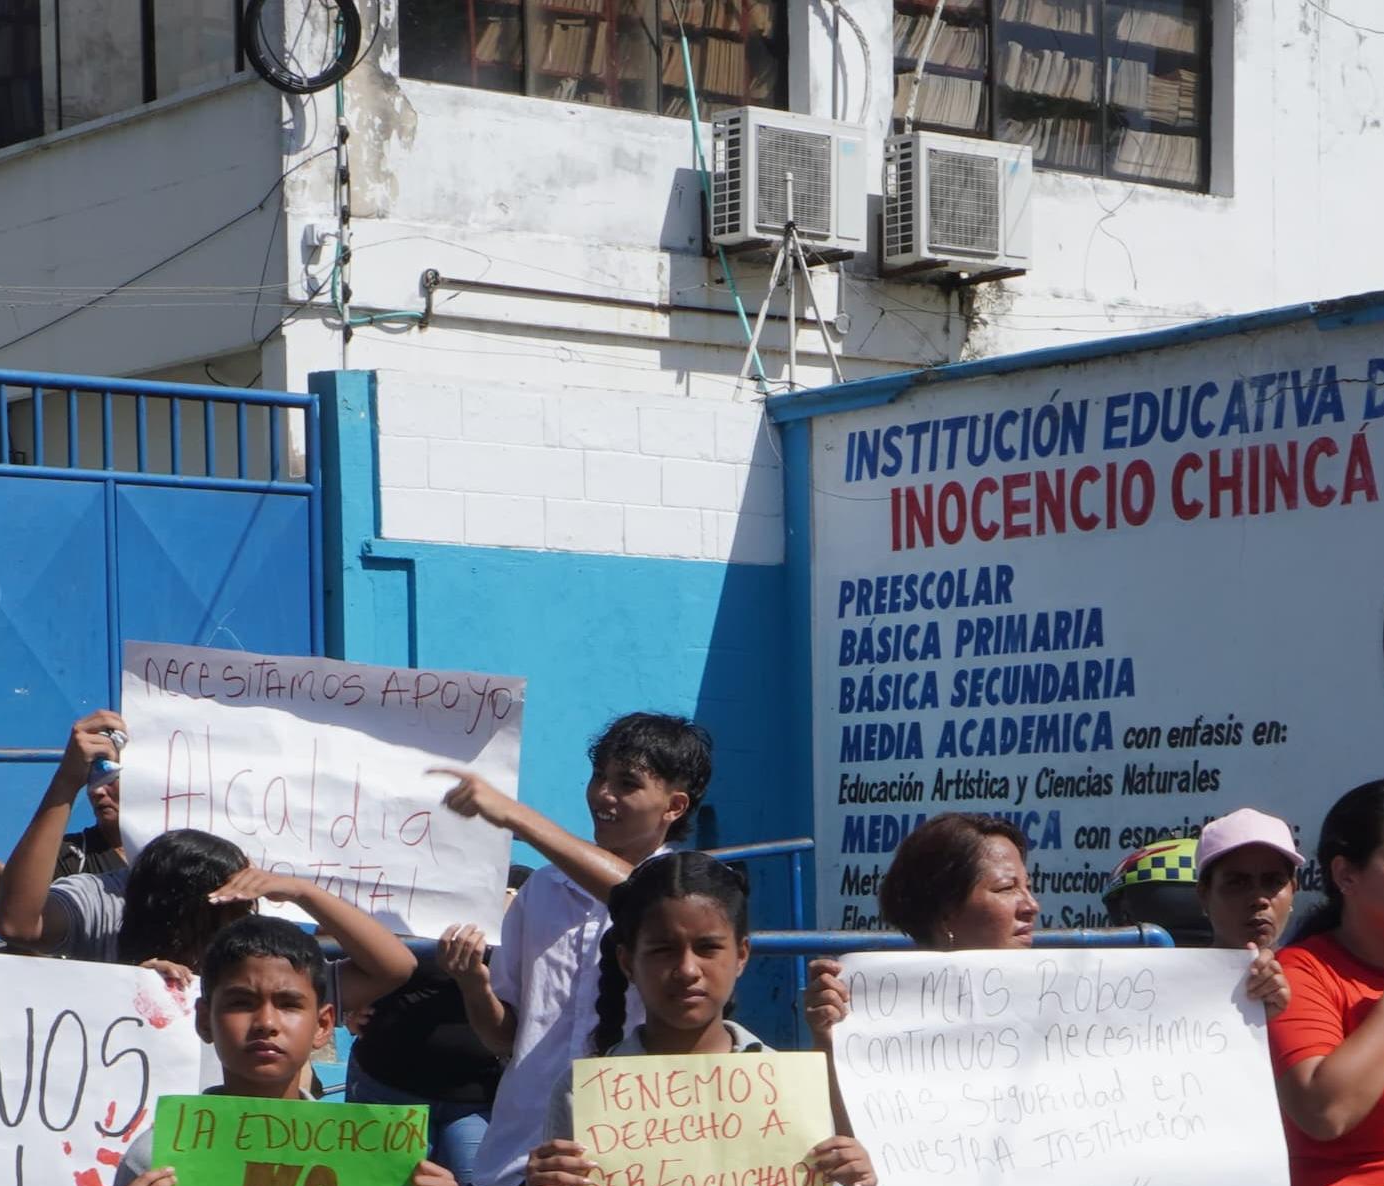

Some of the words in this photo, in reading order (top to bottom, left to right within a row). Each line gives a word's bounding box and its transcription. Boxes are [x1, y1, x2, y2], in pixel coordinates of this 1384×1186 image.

[845, 389, 1088, 483] INSTITUCIÓN
[1103, 365, 1345, 451] EDUCATIVA
[891, 459, 1155, 551] INOCENCIO
[1171, 422, 1378, 521] CHINCÁ
[838, 565, 1014, 618] PREESCOLAR
[839, 618, 941, 667] BÁSICA
[955, 608, 1104, 657] PRIMARIA
[839, 667, 939, 713] BÁSICA
[951, 658, 1135, 708] SECUNDARIA
[840, 721, 924, 763] MEDIA
[936, 711, 1113, 759] ACADEMICA
[1123, 724, 1161, 750] con
[1252, 719, 1288, 746] en:
[838, 772, 924, 805] Educación
[931, 768, 1010, 802] Artística
[1015, 774, 1028, 806] y
[1035, 765, 1113, 800] Ciencias
[1122, 760, 1220, 796] Naturales
[1074, 826, 1111, 850] con
[581, 1062, 779, 1112] TENEMOS
[173, 1103, 215, 1152] LA
[235, 1109, 428, 1155] EDUCACIÓN
[759, 1108, 792, 1140] A
